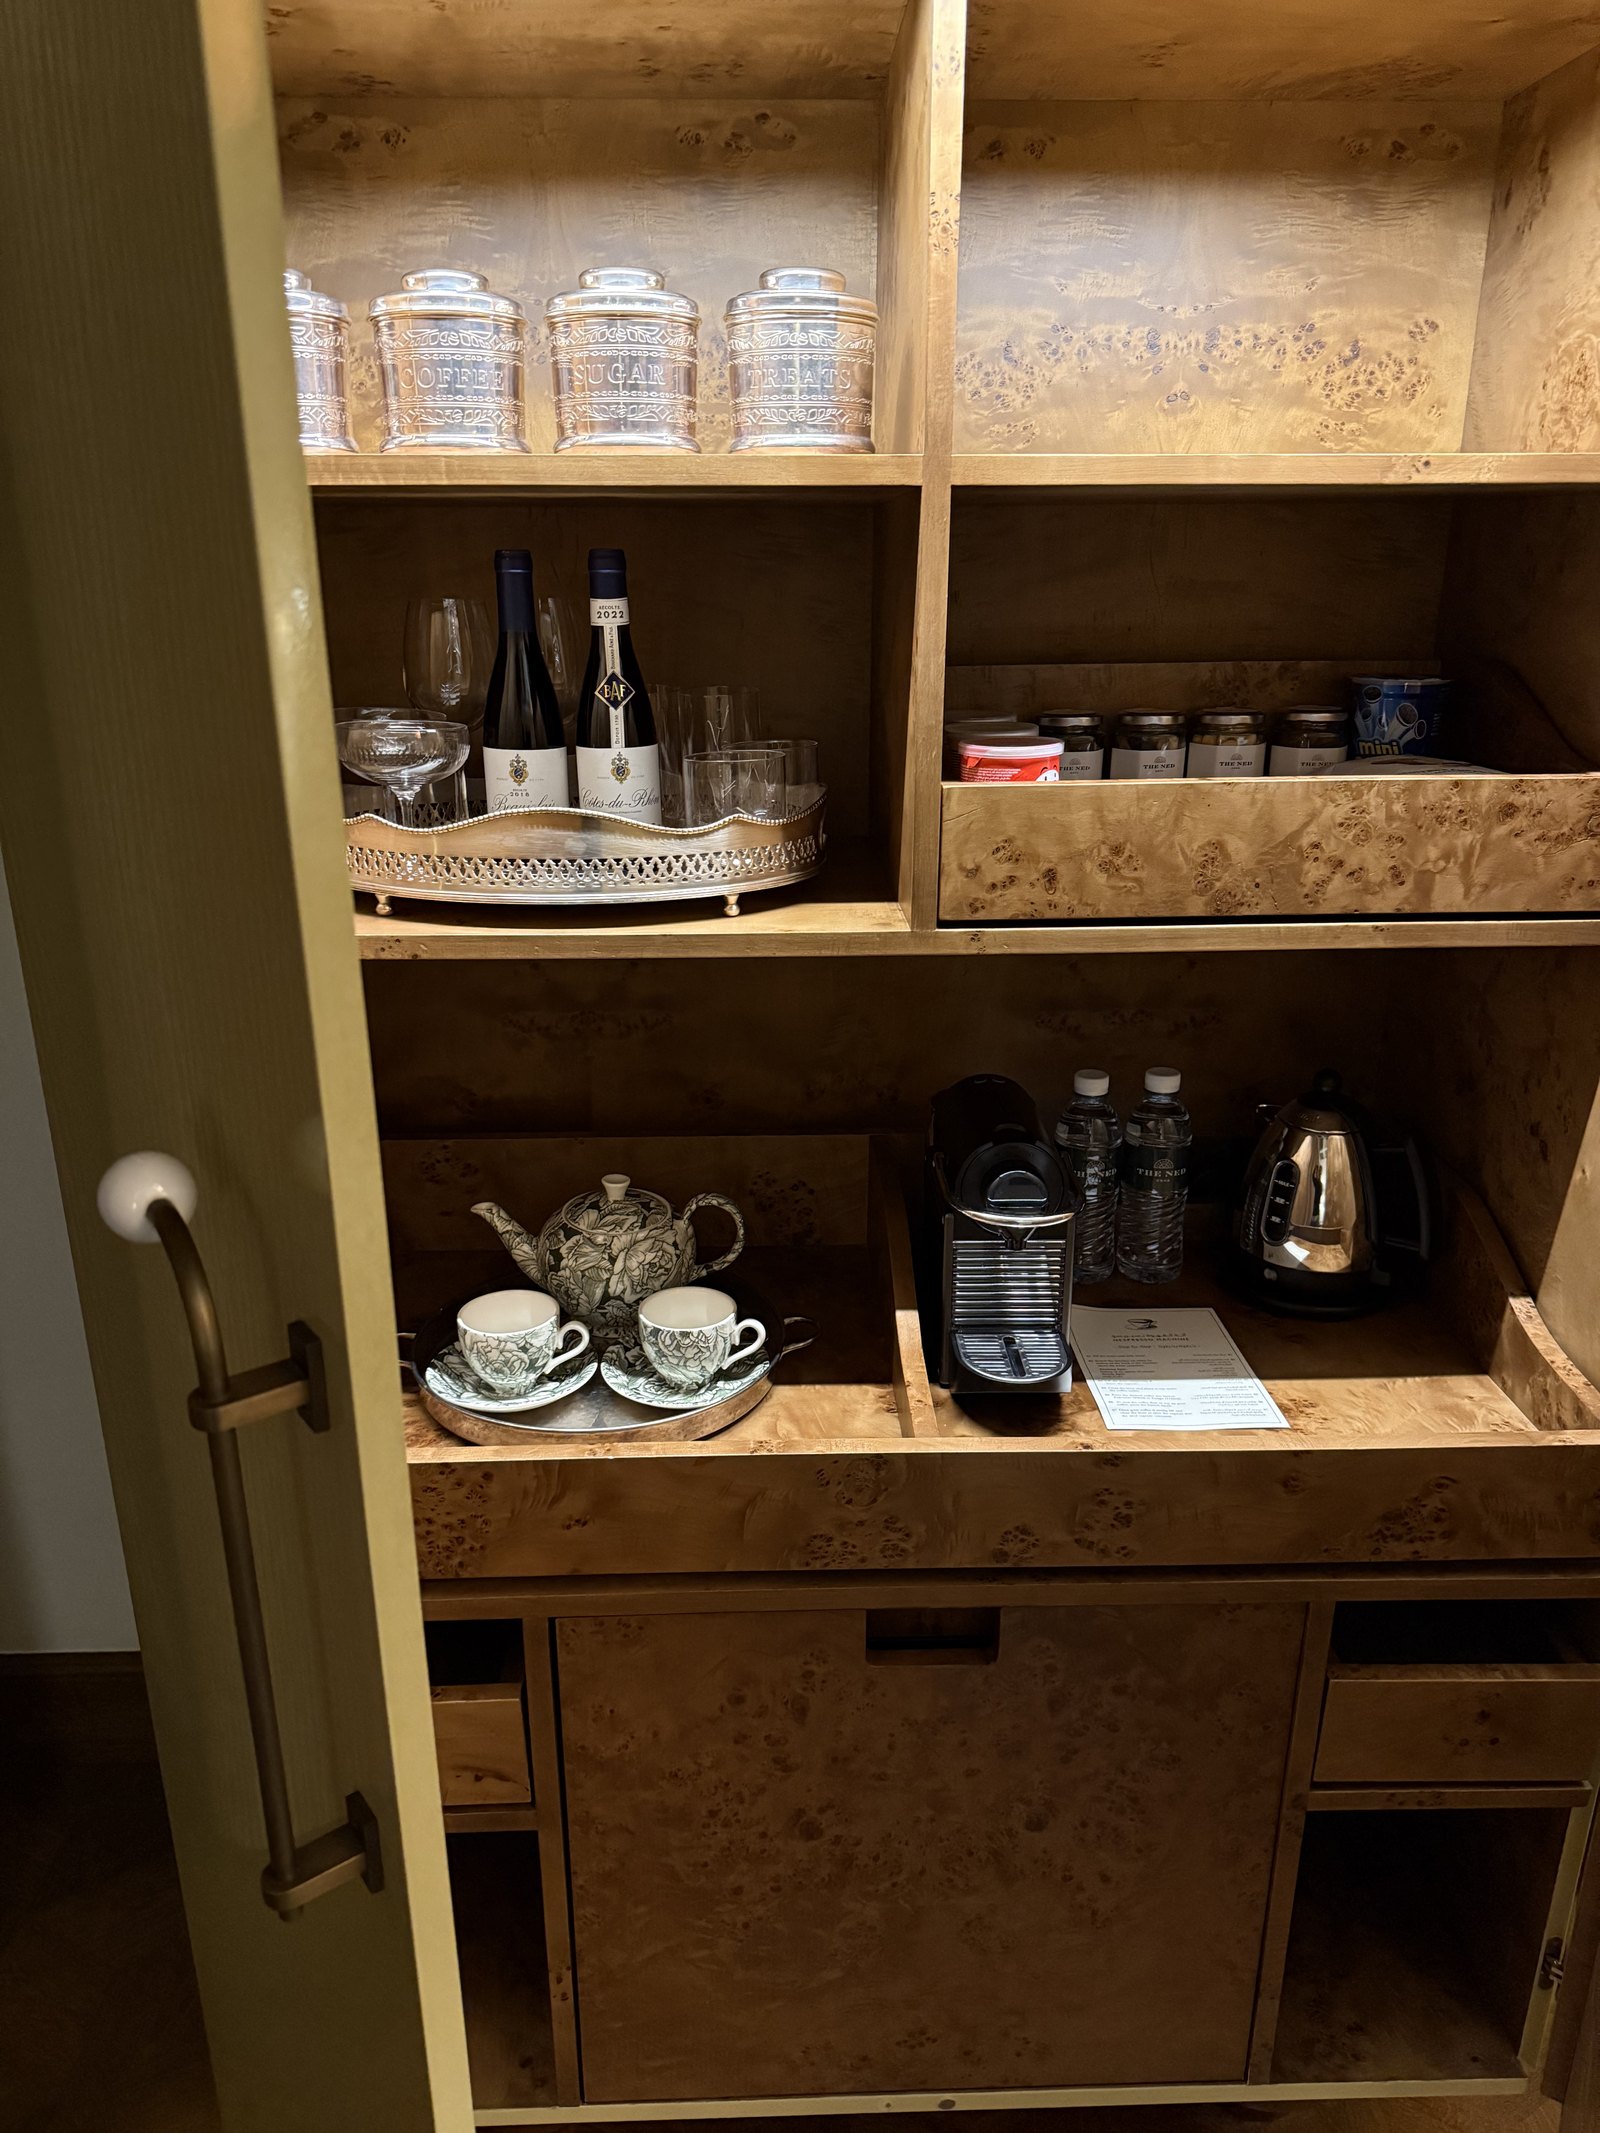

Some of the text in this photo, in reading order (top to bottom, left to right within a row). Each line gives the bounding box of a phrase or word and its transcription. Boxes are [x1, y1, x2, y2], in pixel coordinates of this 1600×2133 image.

[400, 367, 505, 391] COFFEE
[573, 362, 667, 386] SUGAR
[747, 367, 852, 390] TREATS
[596, 610, 625, 619] 2022
[603, 680, 627, 701] BAF
[1357, 739, 1401, 756] mini
[1136, 1167, 1187, 1178] THE NED
